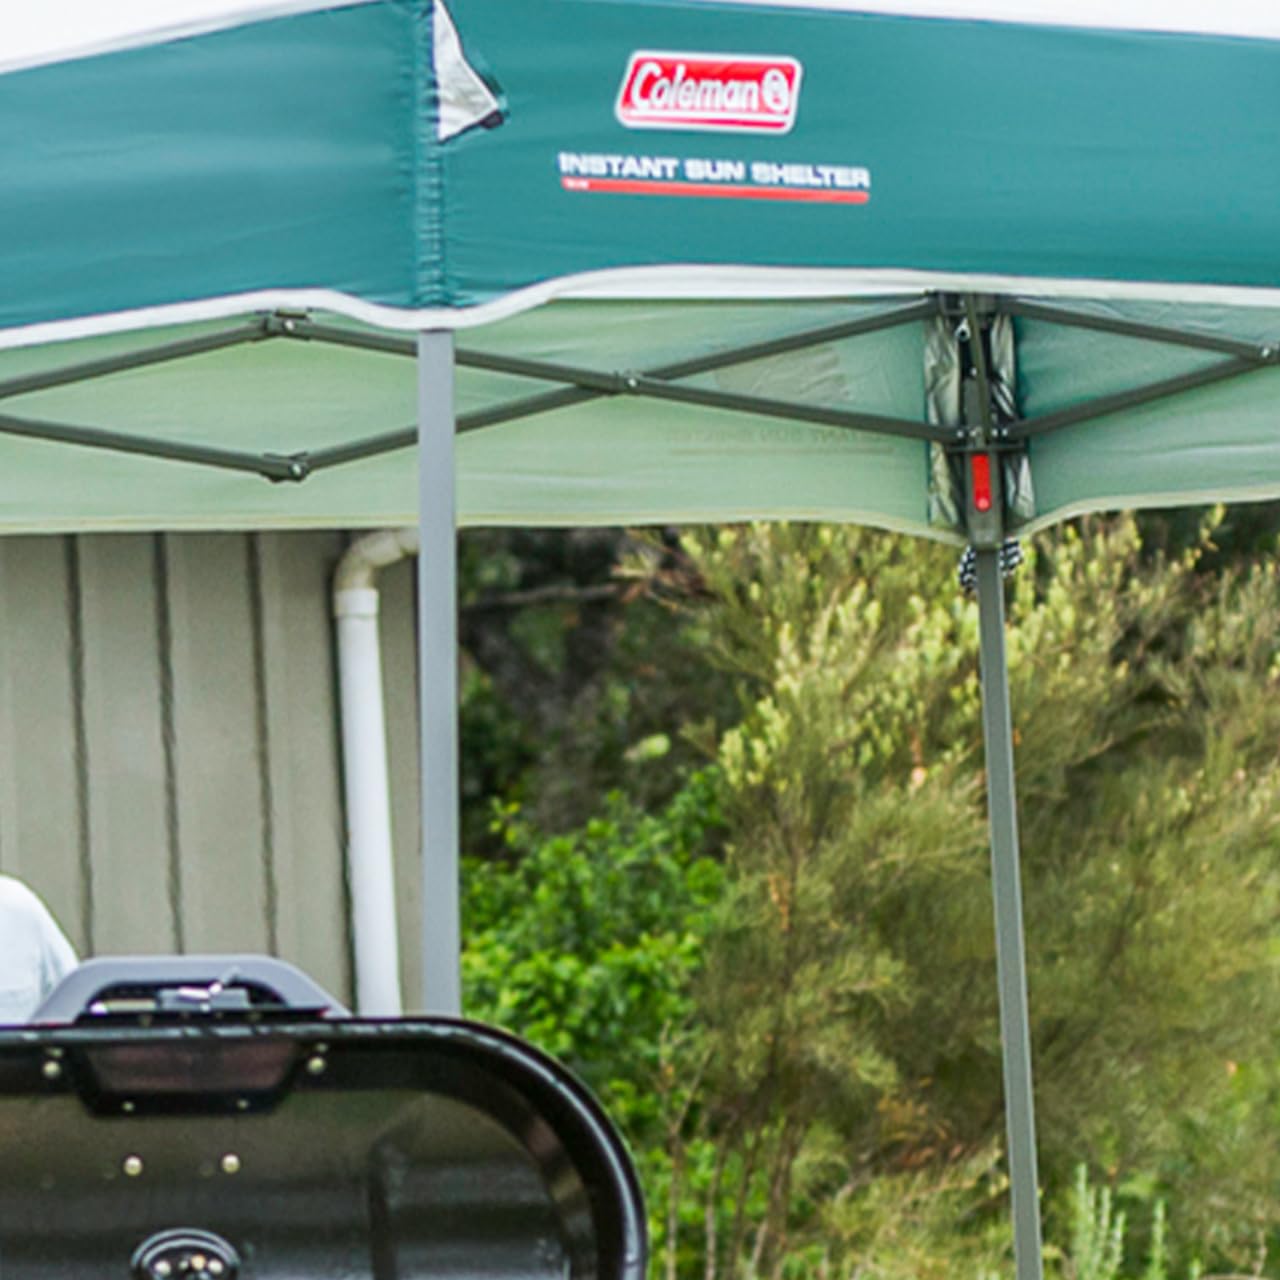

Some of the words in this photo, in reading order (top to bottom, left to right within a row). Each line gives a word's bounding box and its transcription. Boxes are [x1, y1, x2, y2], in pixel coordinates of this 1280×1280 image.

[630, 61, 759, 112] Coleman
[559, 151, 679, 179] INSTANT
[684, 158, 745, 181] SUN
[751, 161, 870, 189] SHELTER
